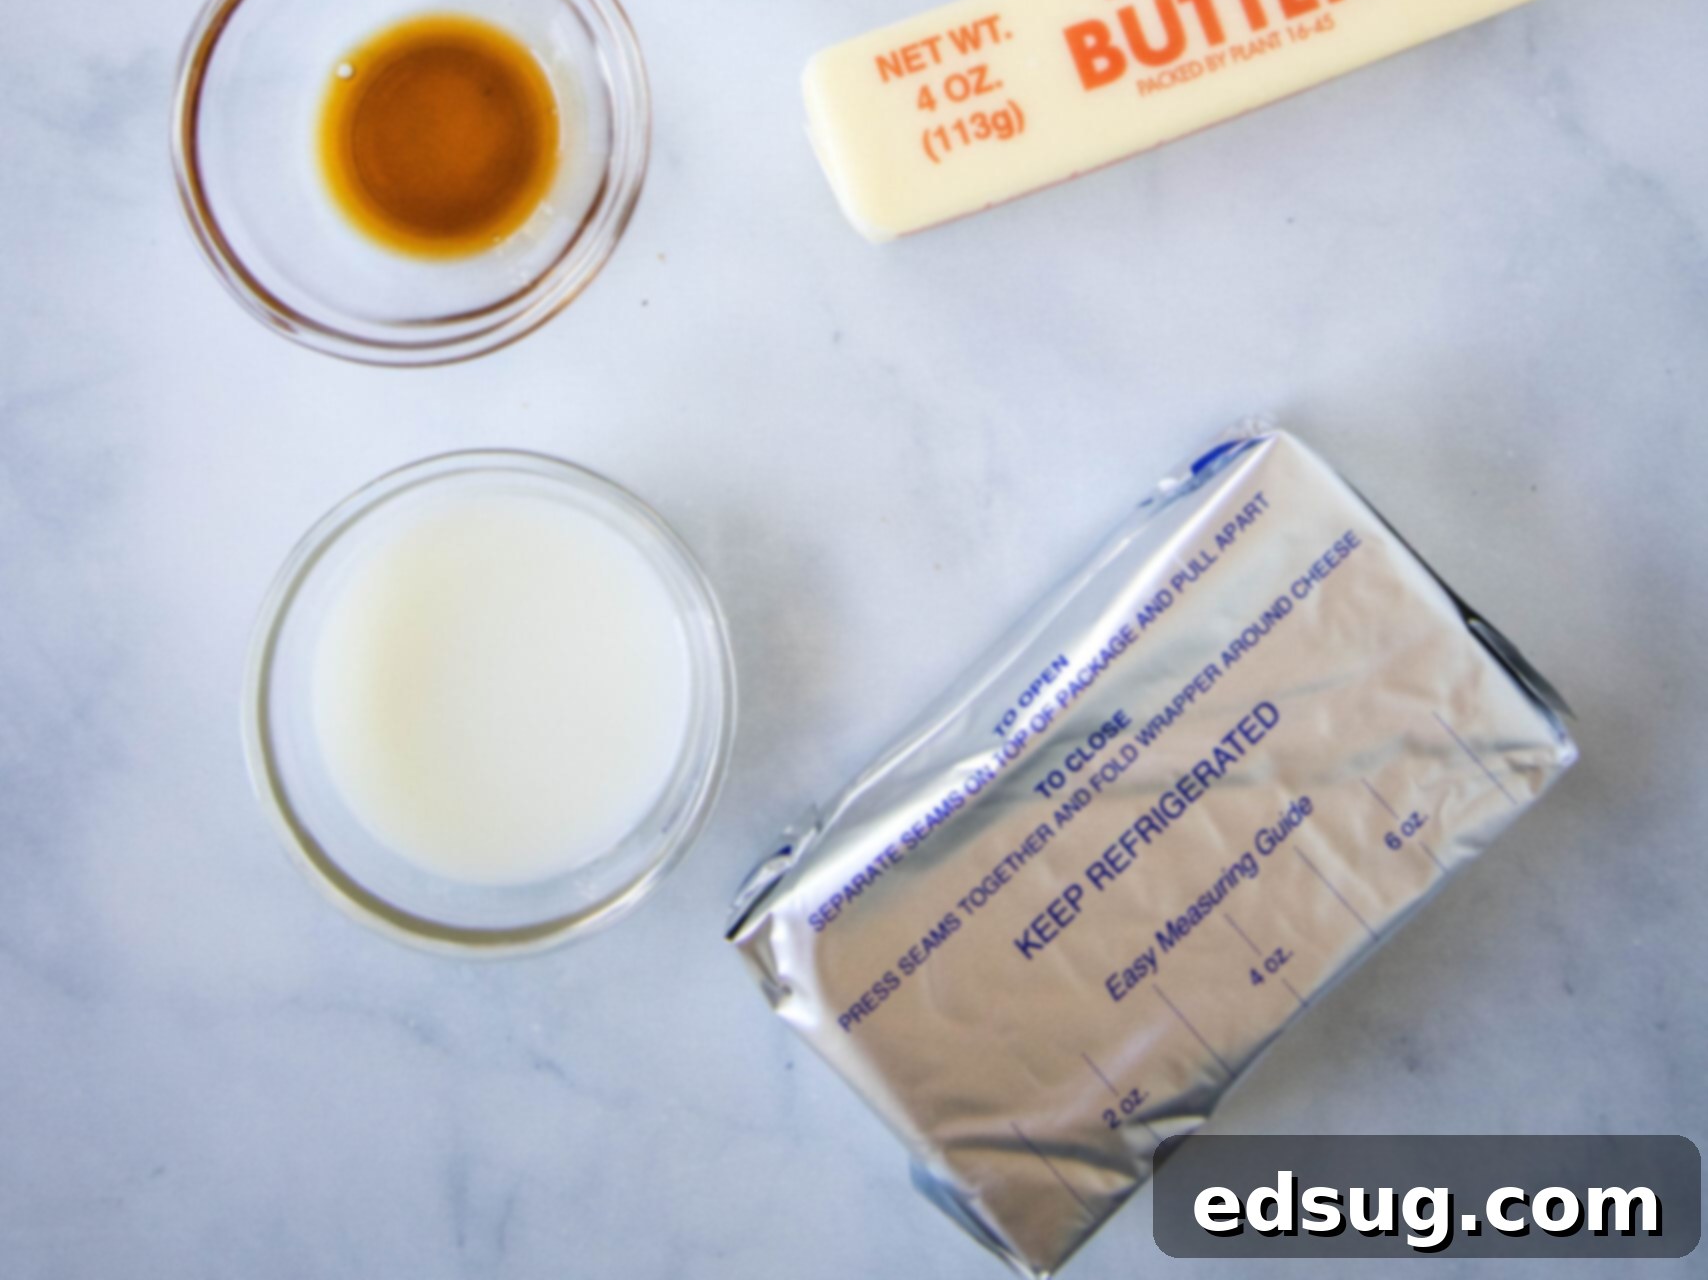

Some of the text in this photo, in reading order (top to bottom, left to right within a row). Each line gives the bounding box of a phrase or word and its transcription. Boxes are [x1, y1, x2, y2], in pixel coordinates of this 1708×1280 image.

[874, 14, 1013, 83] NET WT.
[1136, 62, 1205, 98] PACKED
[1205, 52, 1227, 73] BY
[1228, 29, 1283, 64] PLANT
[915, 65, 1004, 113] 4 OZ.
[921, 98, 1028, 164] (113g)
[808, 491, 1271, 933] SEPARATE SEAMS ON TOP OF PACKAGE AND PULL APART
[993, 653, 1071, 738] TO OPEN
[837, 528, 1363, 1033] PRESS SEAMS TOGETHER AND FOLD WRAPPER AROUND CHEESE
[1034, 708, 1133, 801] TO CLOSE
[1012, 698, 1282, 961] KEEP REFRIGERATED
[1383, 807, 1430, 853] 6 oz.
[1105, 795, 1313, 1003] Easy Measuring Guide
[1248, 943, 1294, 990] 4 oz.
[1102, 1086, 1150, 1131] 2 oz.
